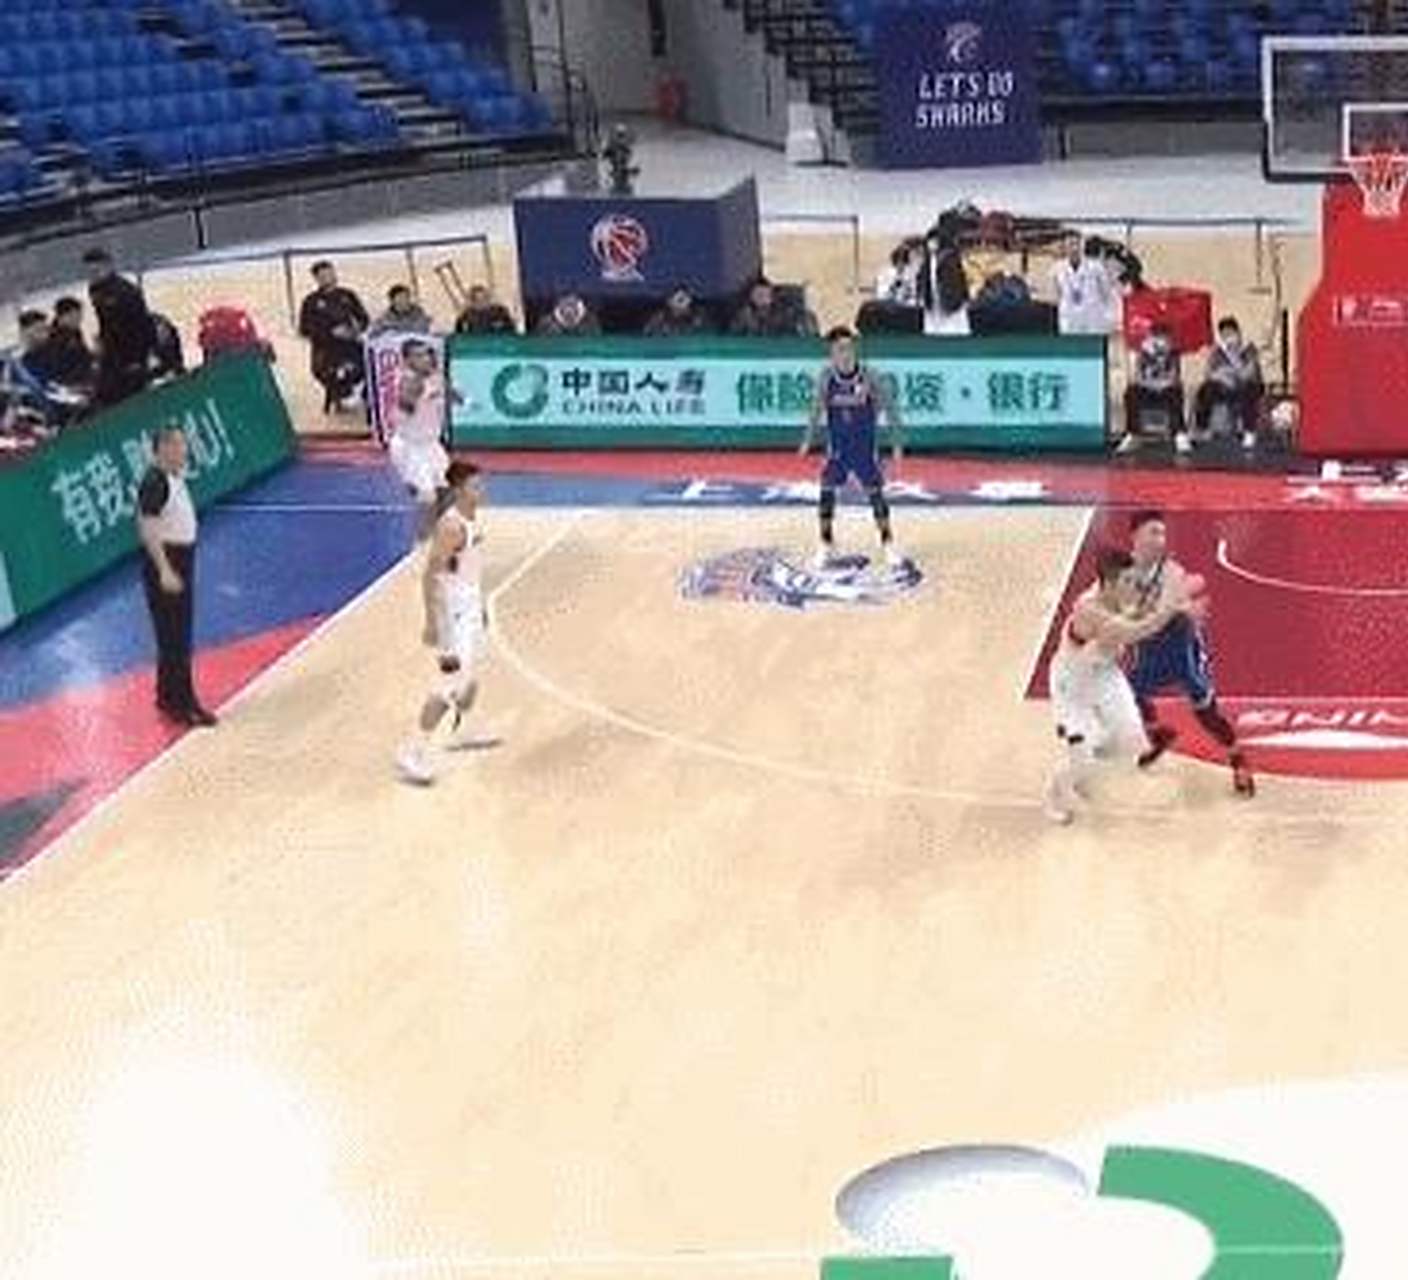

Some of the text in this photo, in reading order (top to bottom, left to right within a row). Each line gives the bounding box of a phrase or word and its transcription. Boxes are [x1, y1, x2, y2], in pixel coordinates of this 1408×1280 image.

[561, 367, 707, 396] 中国人寿
[561, 399, 707, 416] CHINA LIFE
